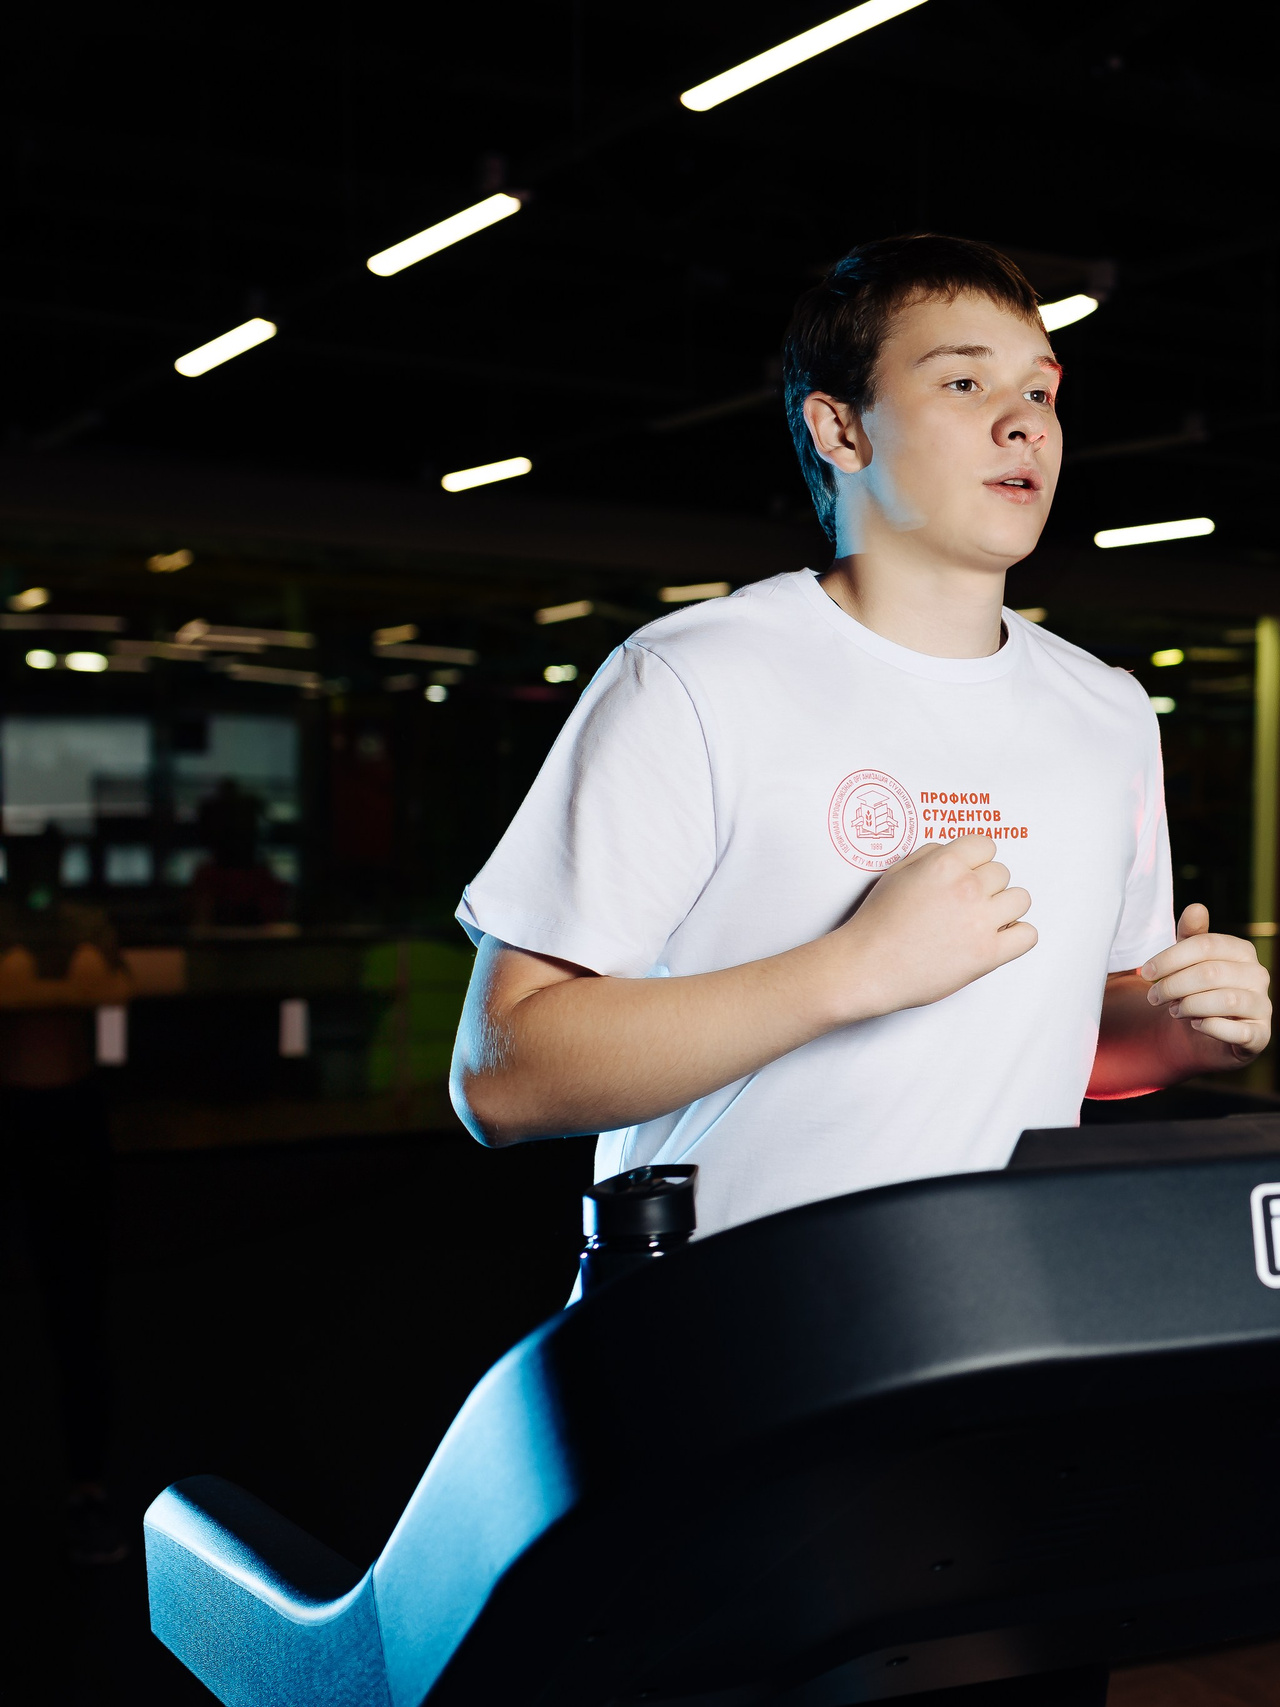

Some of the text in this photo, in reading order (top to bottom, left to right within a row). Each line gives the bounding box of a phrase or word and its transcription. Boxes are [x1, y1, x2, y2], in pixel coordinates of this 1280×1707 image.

[920, 791, 991, 805] ПРОФКОМ
[922, 808, 1002, 824] СТУДЕНТОВ
[924, 826, 934, 839] И
